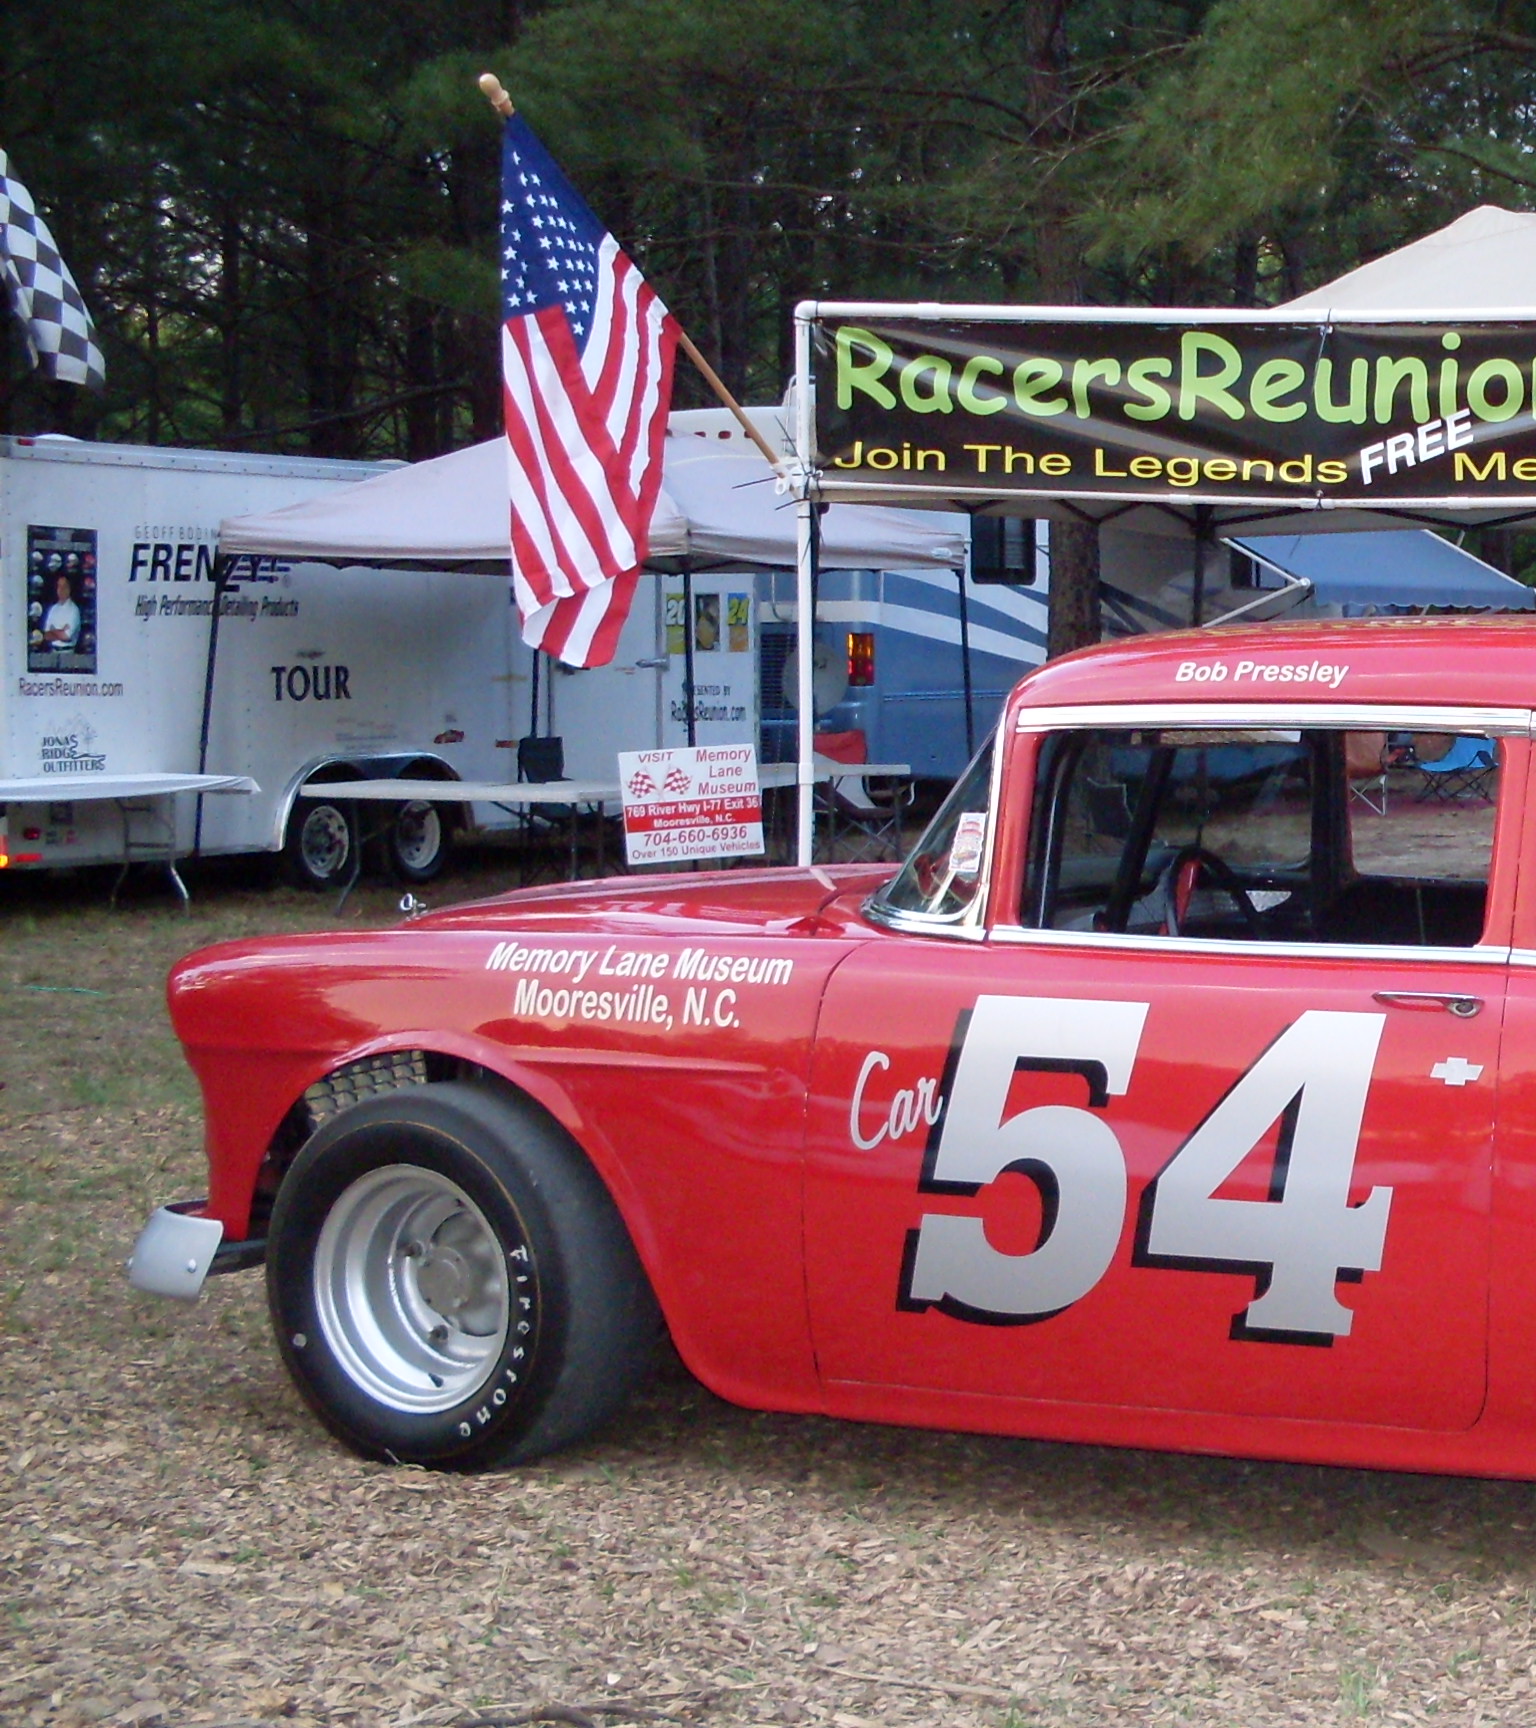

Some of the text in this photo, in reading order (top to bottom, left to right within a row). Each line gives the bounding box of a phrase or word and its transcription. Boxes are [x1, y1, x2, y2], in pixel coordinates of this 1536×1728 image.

[834, 441, 946, 471] Join
[963, 444, 1072, 476] The
[1095, 448, 1348, 487] Legends
[1360, 408, 1475, 486] FREE
[135, 525, 175, 539] GEOFF
[135, 595, 157, 622] High
[159, 595, 216, 616] Performanc
[261, 597, 299, 616] Products
[727, 597, 749, 626] 24
[271, 665, 352, 701] TOUR
[1175, 660, 1350, 689] Bob Pressley
[19, 677, 123, 696] RacersReunion.com
[42, 735, 78, 748] JONAS
[42, 748, 79, 759] RIDGE
[638, 751, 674, 763] VISIT
[696, 749, 751, 763] Memory
[44, 760, 106, 773] OUTFITTERS
[709, 765, 743, 778] Lane
[698, 781, 756, 796] Museum
[627, 797, 758, 817] 769 River Hwy I-77 Exit 36
[715, 813, 736, 823] N.C.
[644, 825, 748, 848] 704-660-6936
[632, 840, 761, 860] Over 150 Unique Vehicles
[485, 942, 795, 985] Memory Lane Museum
[513, 978, 741, 1031] Mooresville, N.C.
[849, 994, 1394, 1347] Car 54
